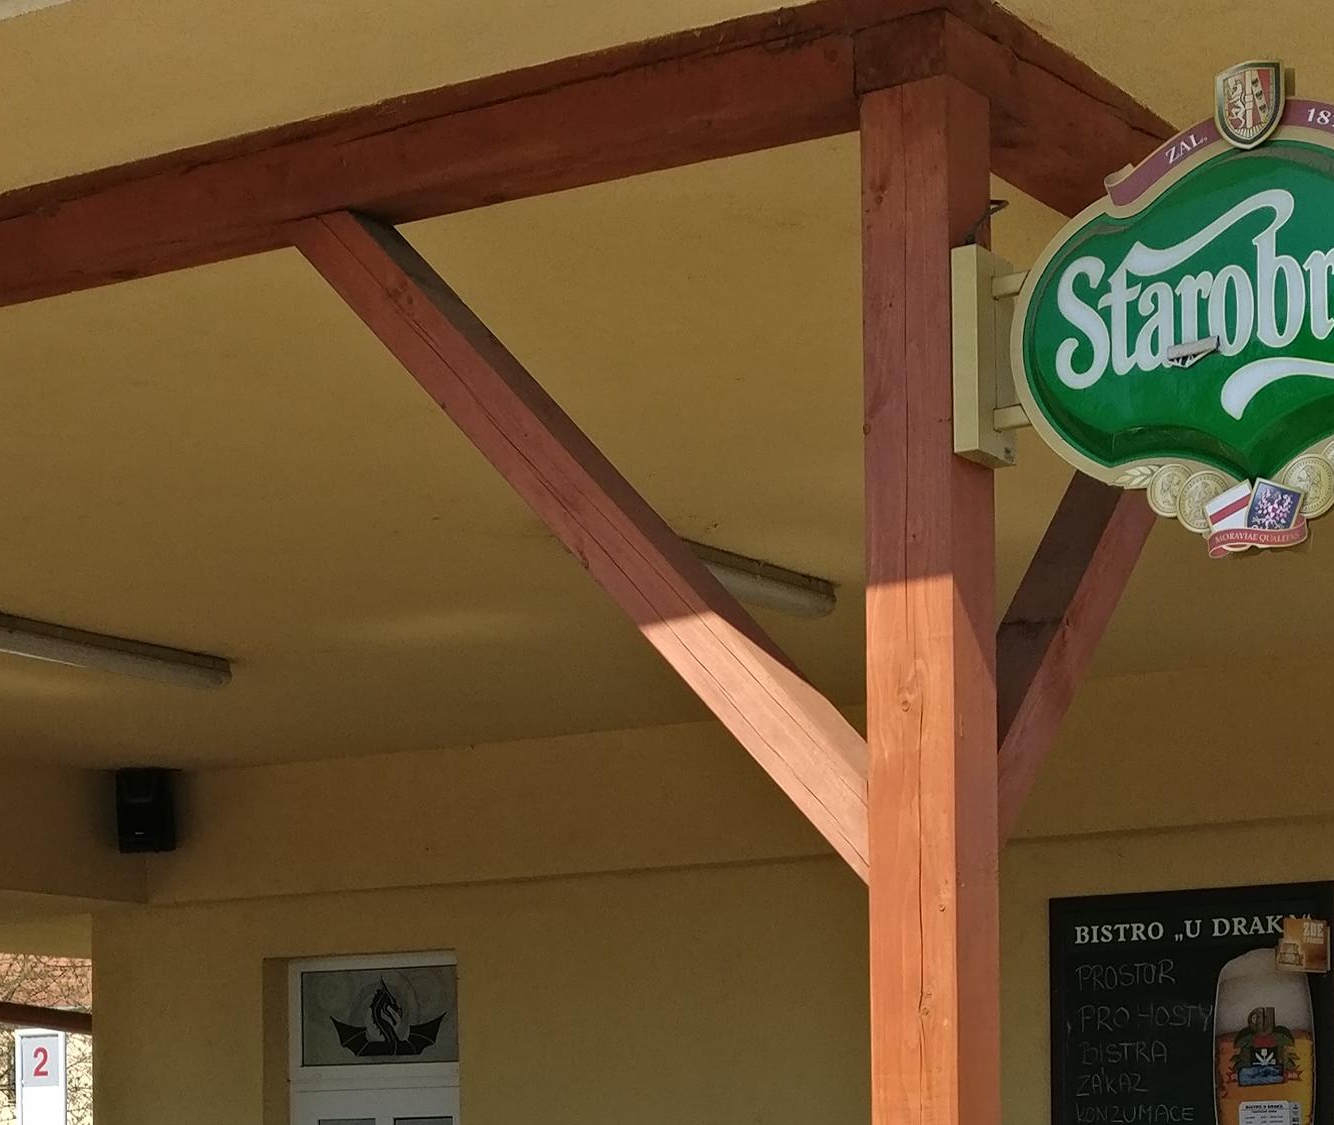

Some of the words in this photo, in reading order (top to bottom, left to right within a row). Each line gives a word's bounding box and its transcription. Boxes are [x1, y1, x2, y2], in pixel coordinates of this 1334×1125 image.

[1075, 921, 1165, 944] BISTRO
[1075, 957, 1177, 991] PROSTOR
[1077, 1004, 1130, 1032] PRO
[33, 1047, 49, 1077] 2
[1076, 1103, 1195, 1123] KONZUMACE
